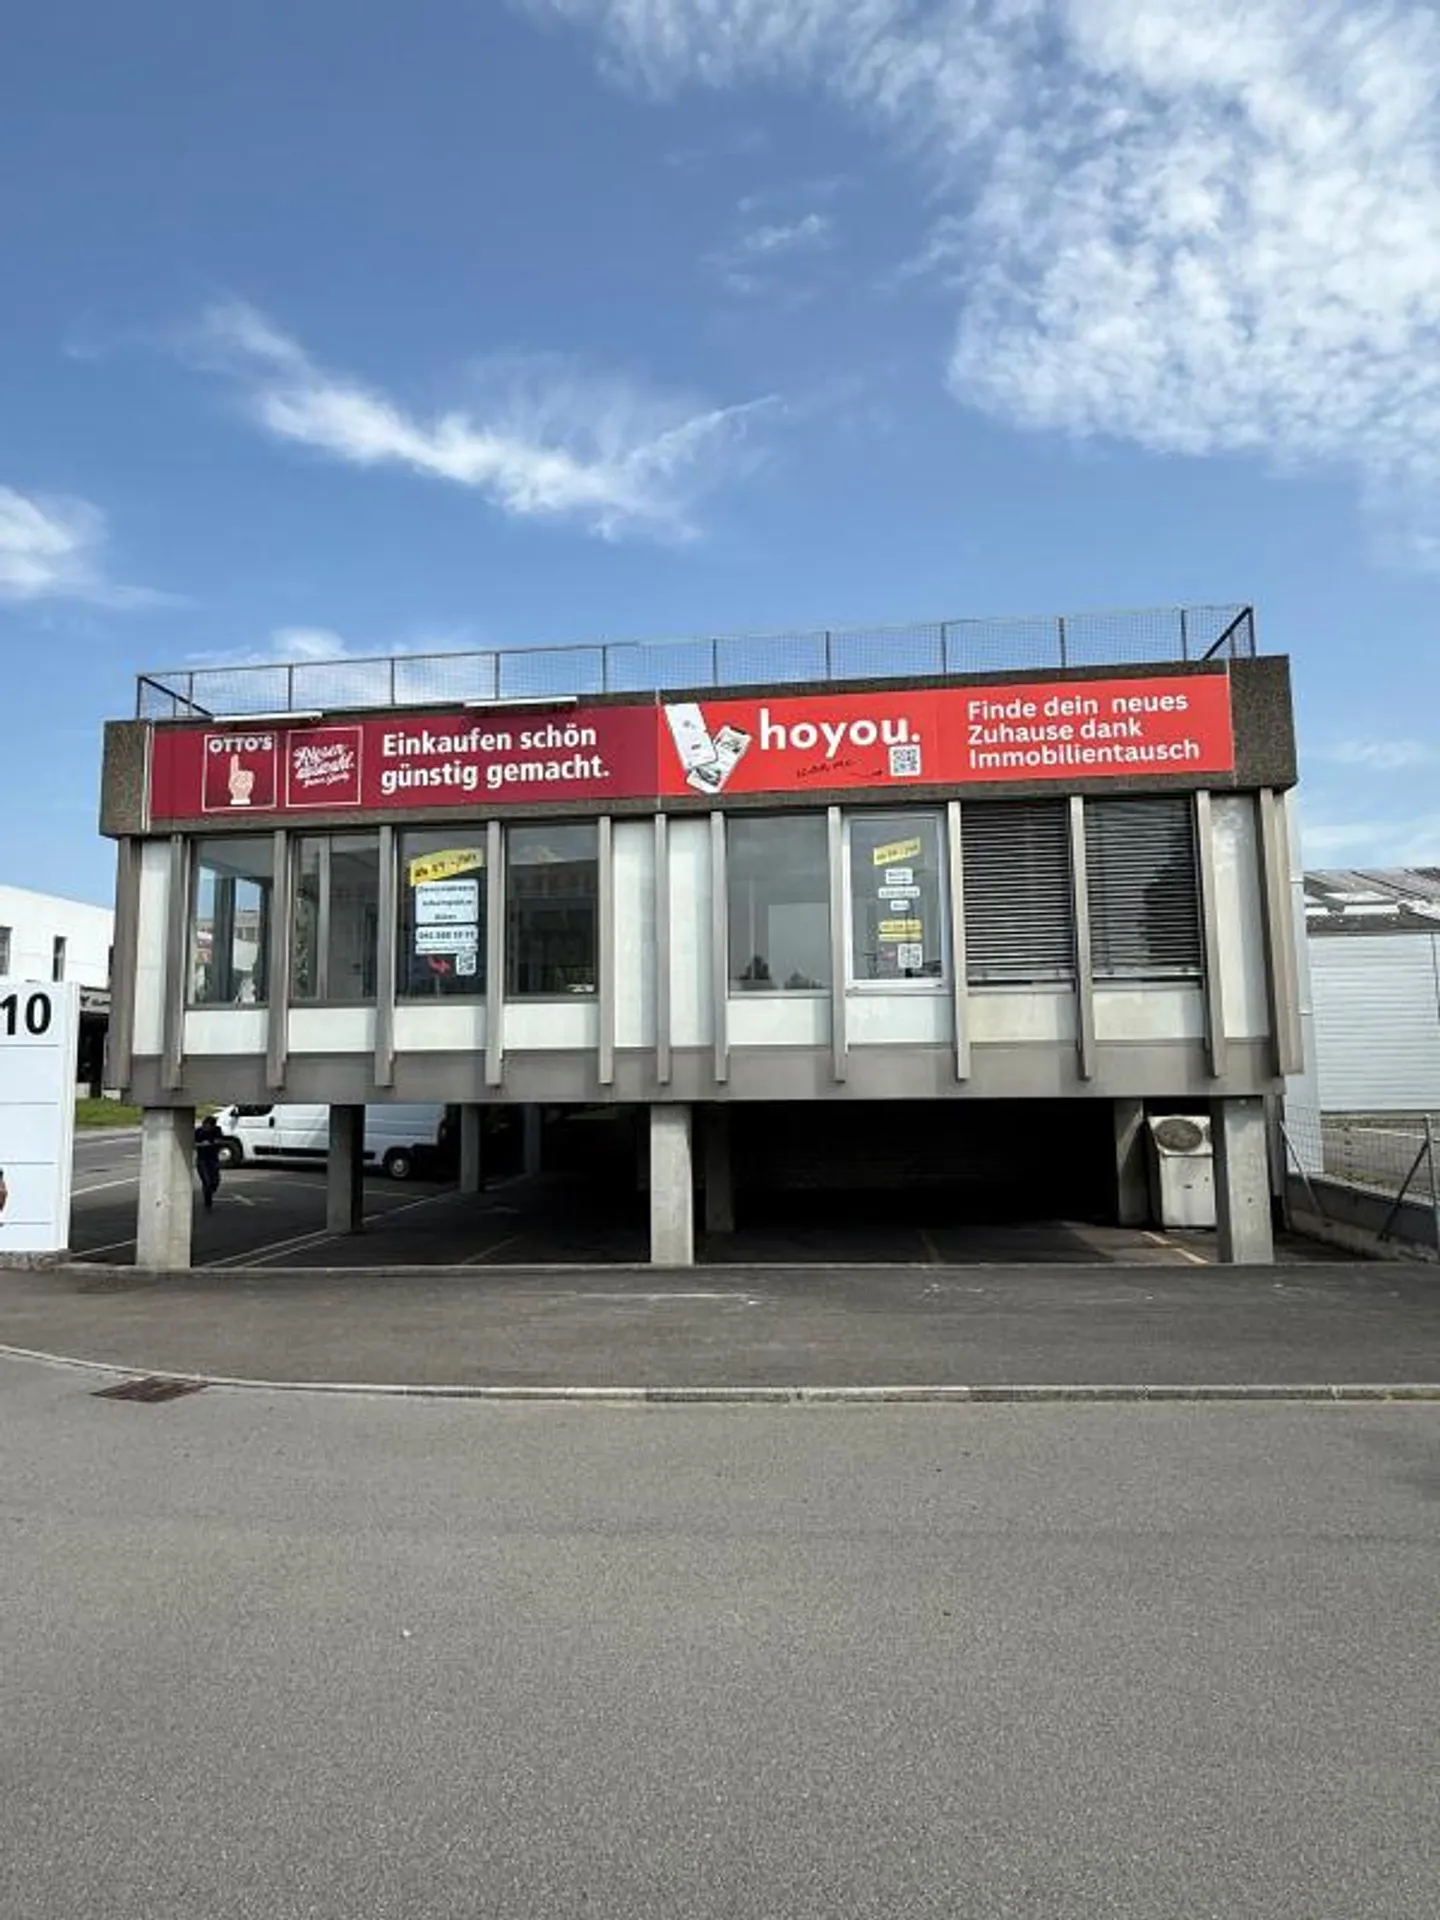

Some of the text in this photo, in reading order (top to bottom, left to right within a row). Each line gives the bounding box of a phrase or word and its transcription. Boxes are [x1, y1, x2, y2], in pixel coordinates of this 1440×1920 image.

[967, 694, 1189, 721] Finde dein neues
[208, 736, 273, 752] OTTO'S
[382, 723, 597, 757] Einkaufen schön
[759, 708, 921, 759] hoyou.
[968, 717, 1143, 745] Zuhause dank
[969, 740, 1200, 769] Immobilientausch
[381, 761, 478, 794] günstig
[486, 754, 610, 789] gemacht.
[0, 992, 52, 1035] 10
